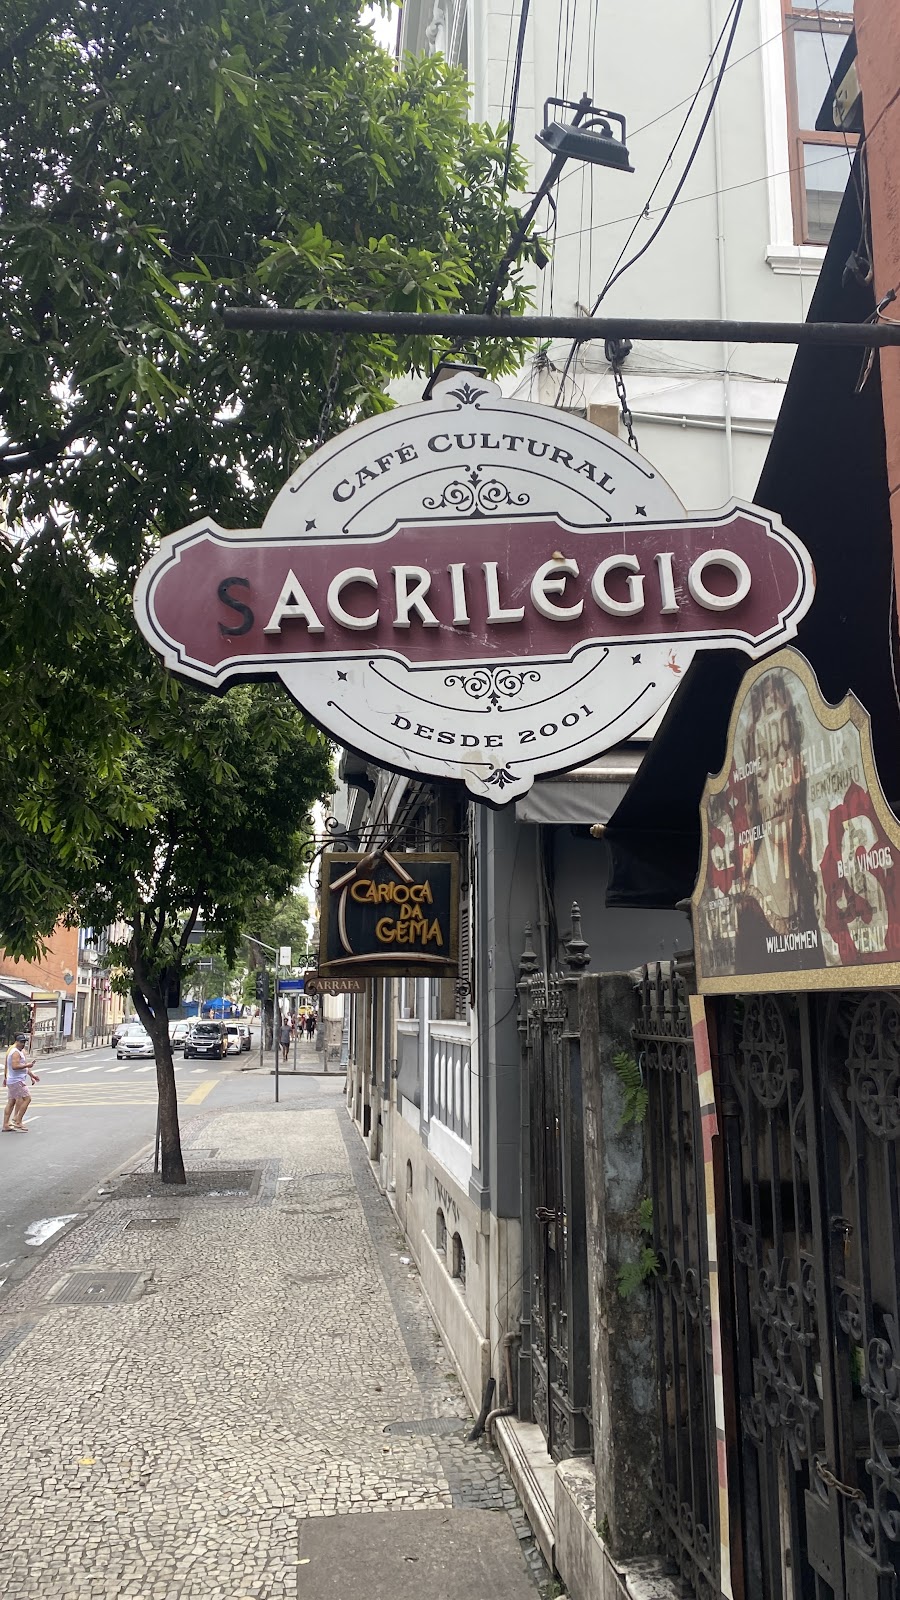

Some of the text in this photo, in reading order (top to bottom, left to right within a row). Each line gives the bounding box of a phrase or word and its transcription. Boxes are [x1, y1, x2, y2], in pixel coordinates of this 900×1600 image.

[332, 433, 616, 502] CAFÉ CULTURAL
[391, 704, 594, 747] DESDE 2001
[733, 756, 762, 784] WELCOME
[837, 846, 893, 879] BEM VINDOS
[351, 879, 433, 904] CARIOCA
[400, 904, 423, 920] DA
[375, 917, 443, 946] GEMA
[766, 929, 818, 954] WILLKOMMEN
